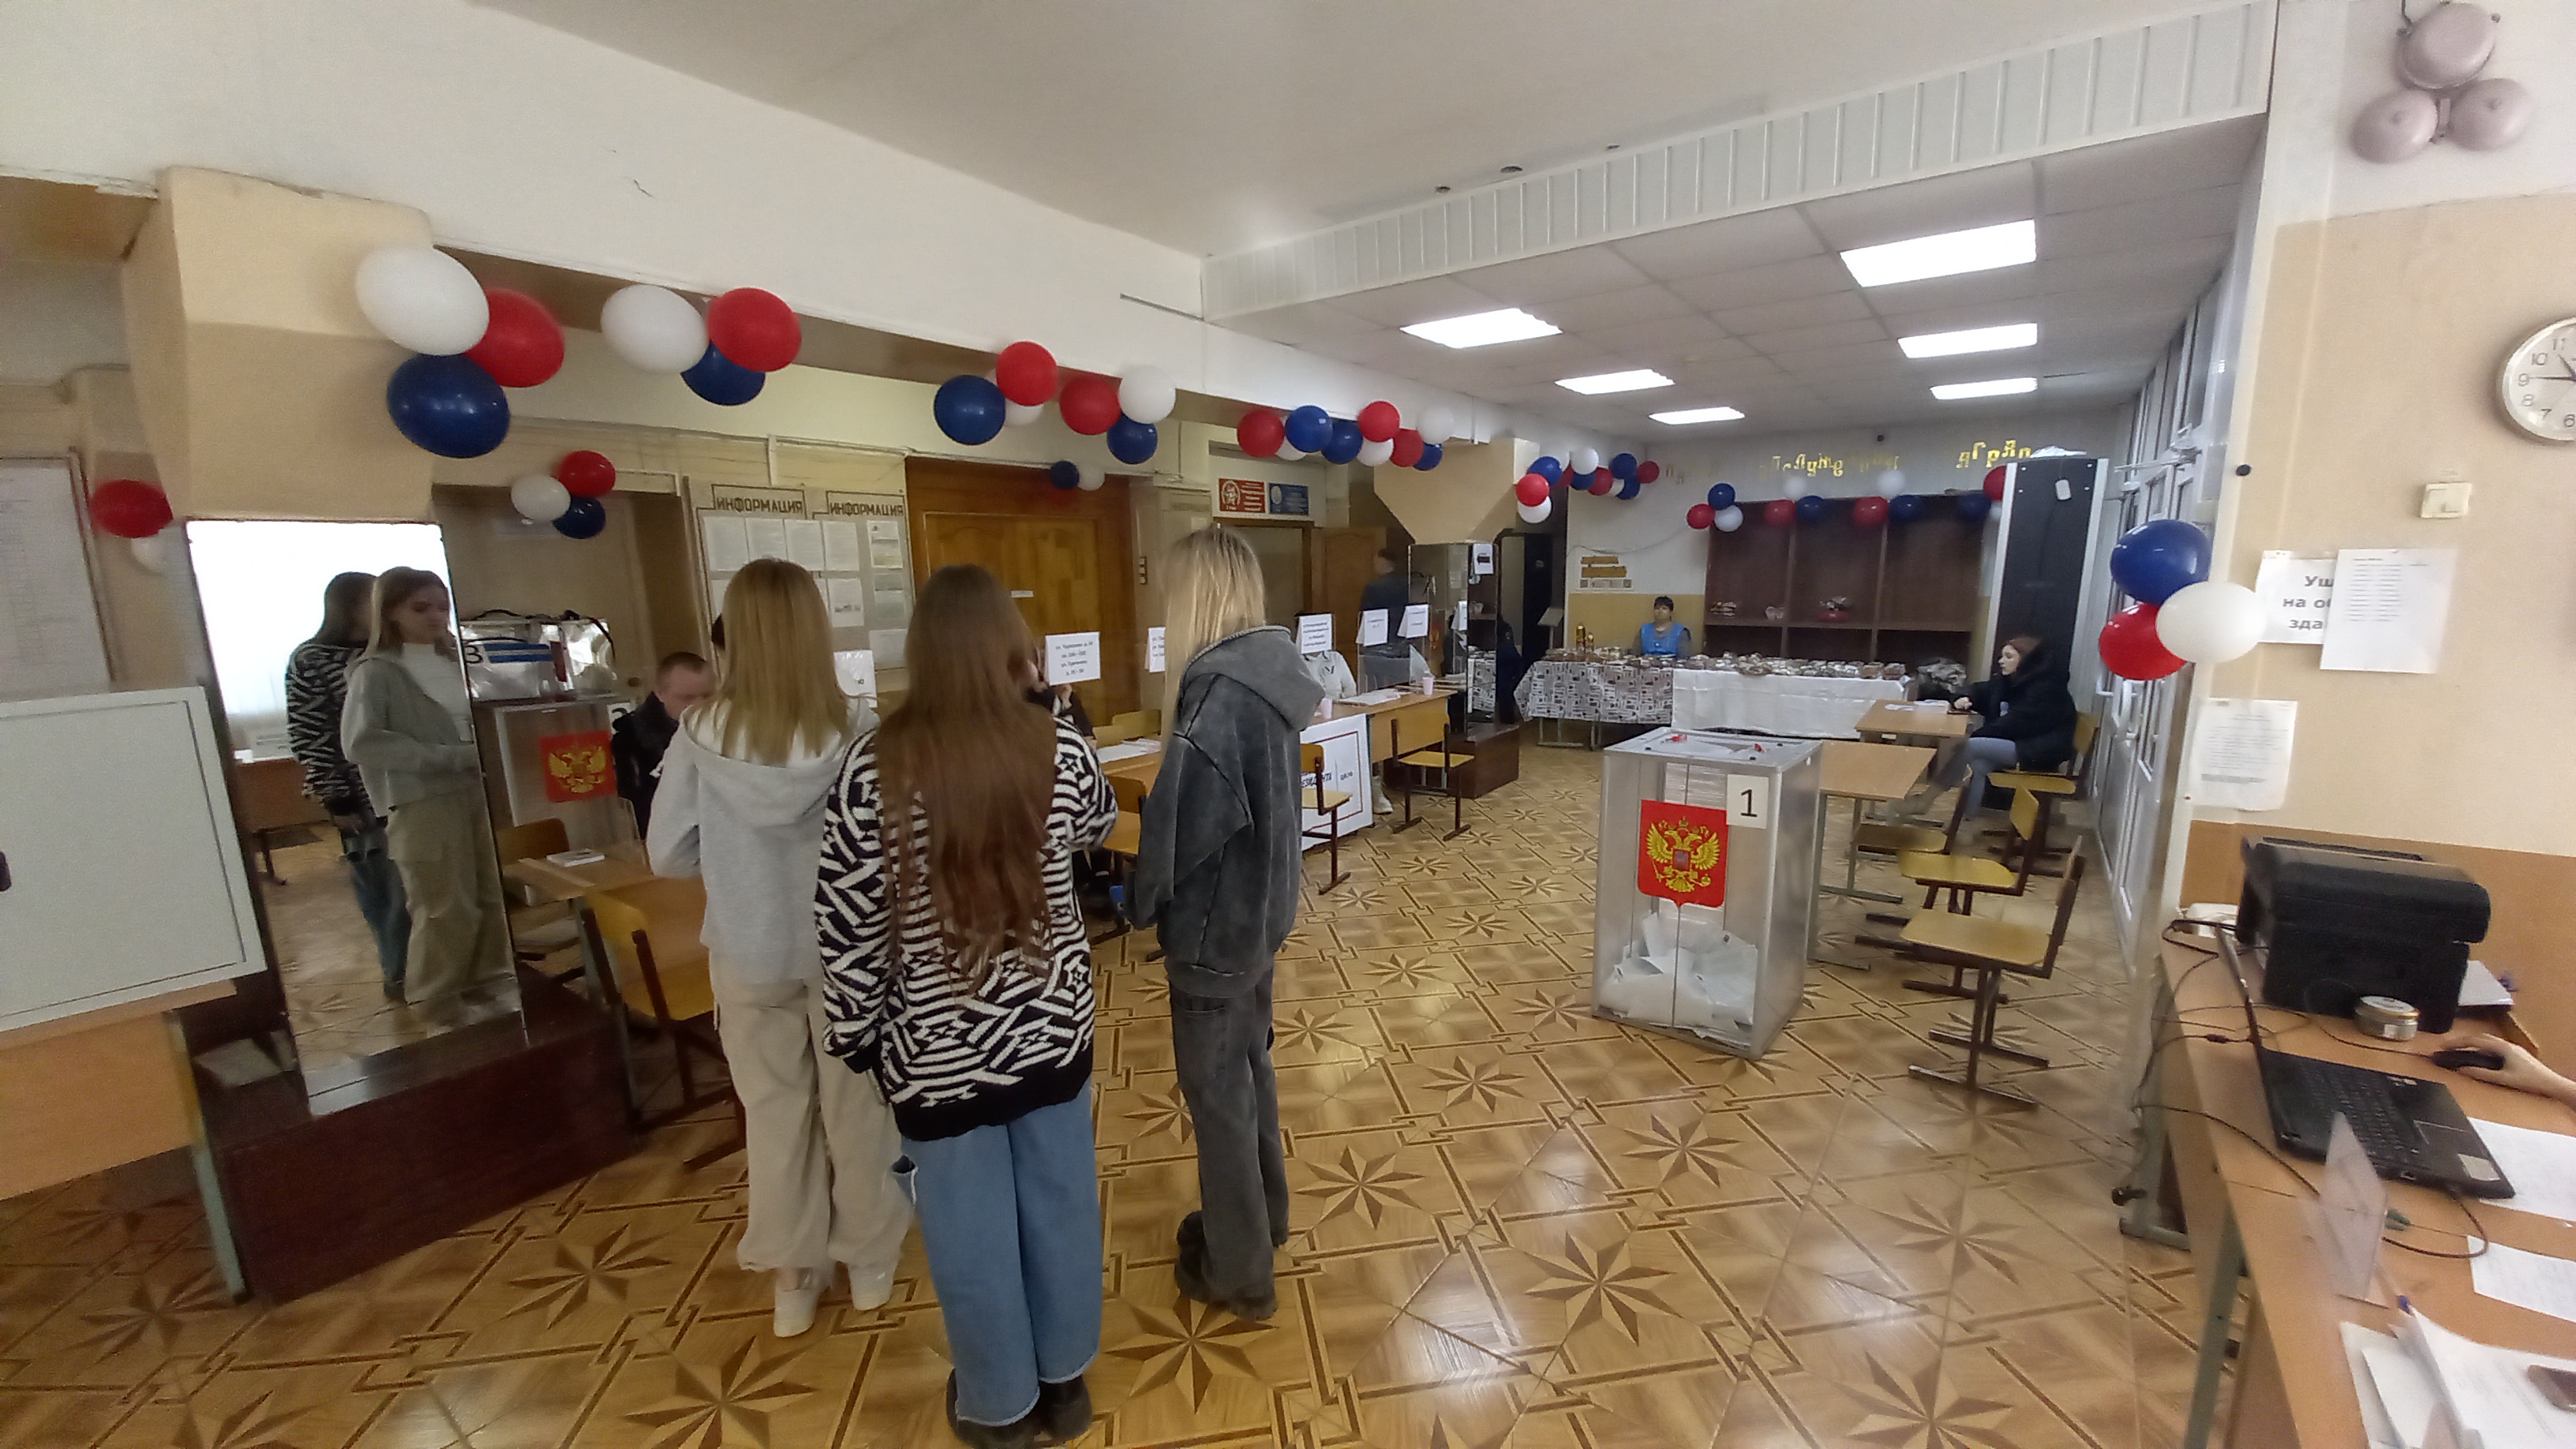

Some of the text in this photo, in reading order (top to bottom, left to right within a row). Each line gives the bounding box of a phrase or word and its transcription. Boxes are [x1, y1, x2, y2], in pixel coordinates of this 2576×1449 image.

[2552, 338, 2566, 351] 11
[2531, 352, 2548, 366] 10
[2518, 373, 2530, 387] 9
[2522, 394, 2533, 407] 8
[2541, 408, 2552, 419] 7
[2564, 414, 2575, 428] 6
[716, 496, 803, 513] ИНФОРМАЦИЯ
[829, 502, 904, 517] ИНФОРМАЦИЯ
[2282, 598, 2307, 608] на
[1740, 788, 1758, 818] 1
